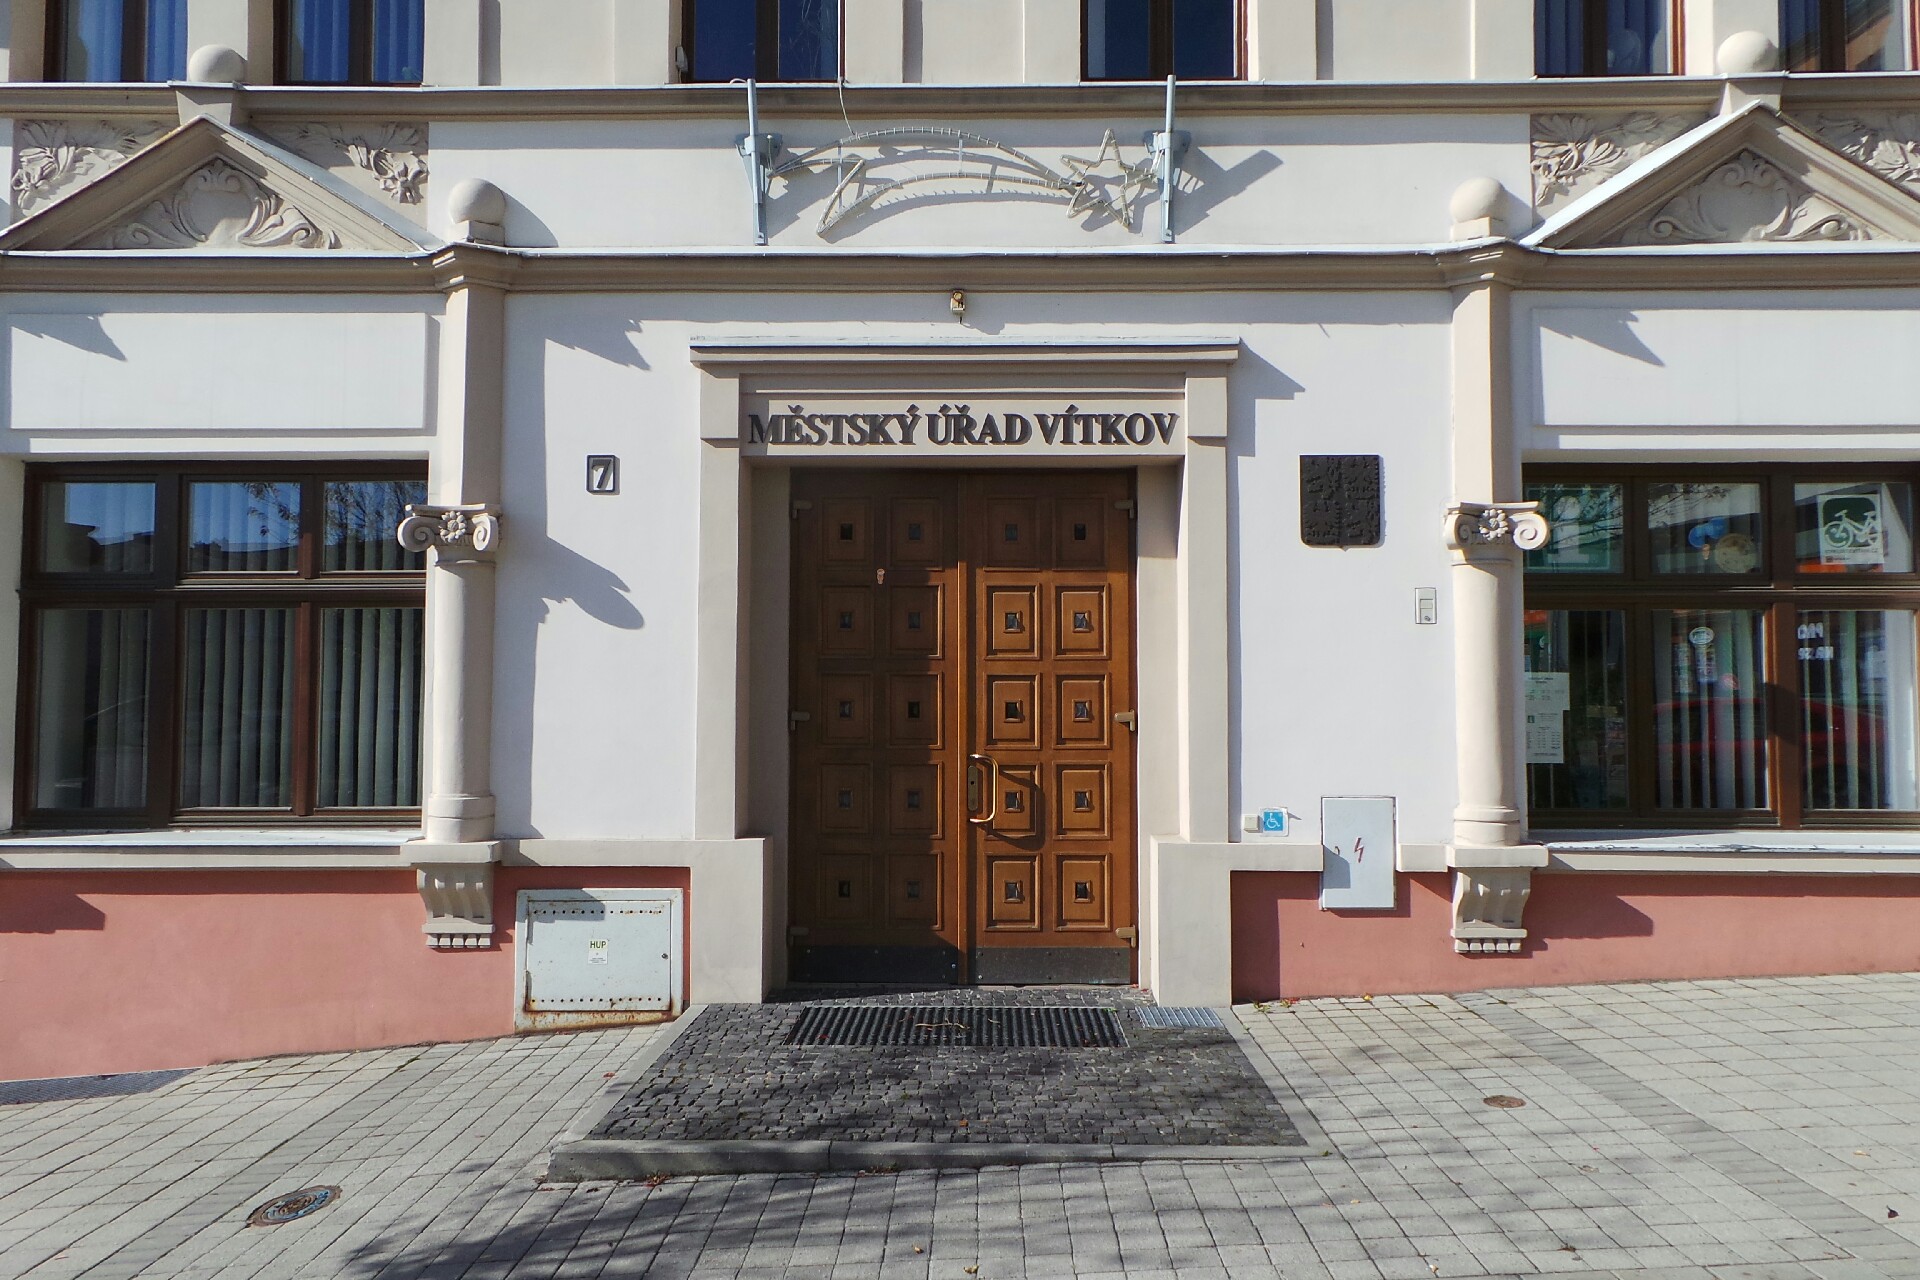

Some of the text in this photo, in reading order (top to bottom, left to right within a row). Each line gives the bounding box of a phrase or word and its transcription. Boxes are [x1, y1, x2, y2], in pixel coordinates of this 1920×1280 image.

[747, 403, 1179, 446] MĚSTSKÝ ÚŘAD VÍTKOV
[591, 459, 612, 489] 7
[589, 940, 607, 949] HUP
